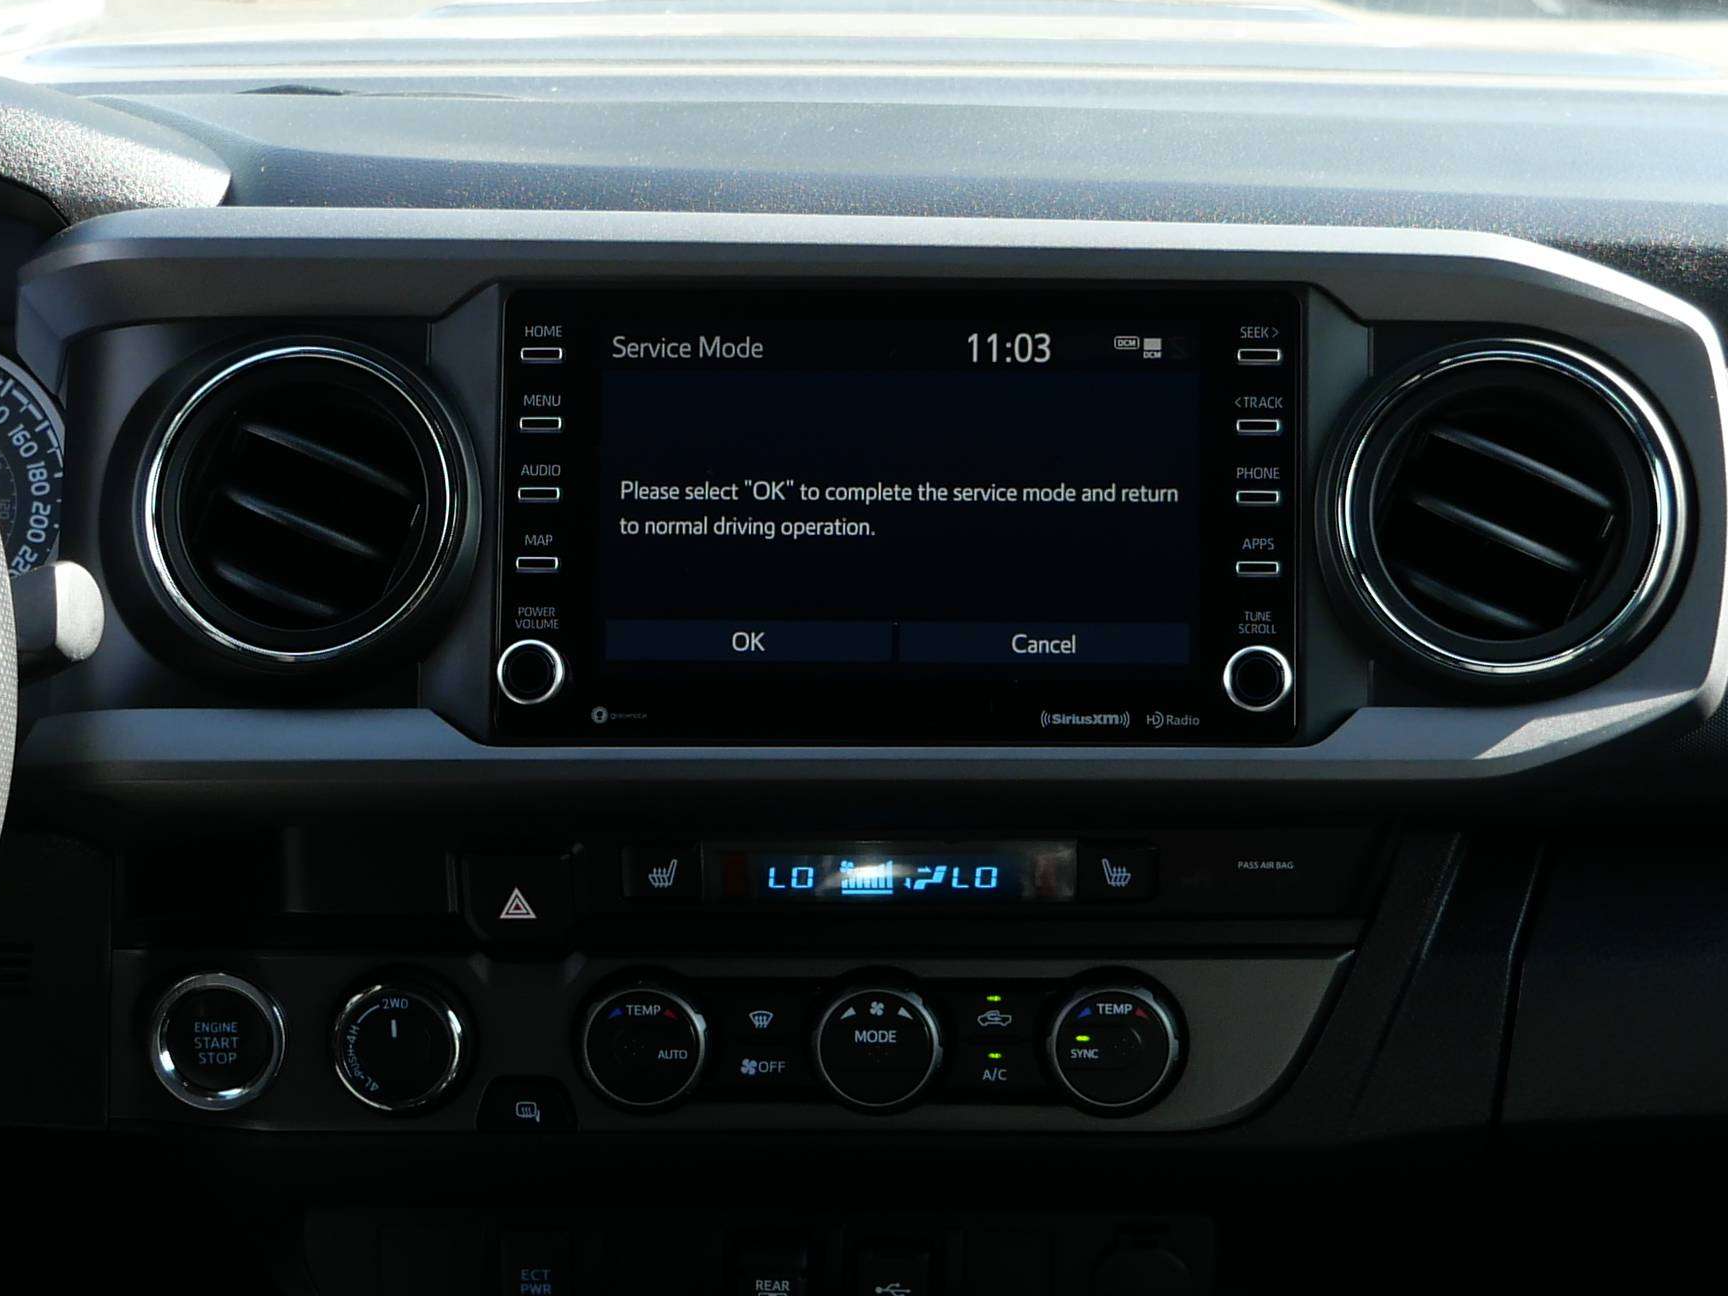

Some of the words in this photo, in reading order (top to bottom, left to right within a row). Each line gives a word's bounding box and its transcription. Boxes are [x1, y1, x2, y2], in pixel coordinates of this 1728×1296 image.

[524, 325, 563, 337] HOME
[1240, 326, 1270, 339] SEEK
[612, 335, 692, 359] Service
[699, 335, 764, 359] Mode
[966, 332, 1052, 364] 11:03
[523, 394, 561, 407] MENU
[1241, 395, 1284, 409] TRACK
[7, 423, 39, 459] 160
[521, 464, 561, 477] AUDIO
[1236, 466, 1281, 480] PHONE
[25, 460, 51, 497] 180
[620, 480, 680, 500] Please
[684, 481, 739, 501] select
[744, 479, 794, 501] "OK"
[800, 482, 820, 501] to
[825, 482, 912, 505] complete
[917, 482, 948, 502] the
[953, 483, 1017, 502] service
[1022, 482, 1076, 502] mode
[1081, 483, 1116, 503] and
[1121, 485, 1179, 503] return
[25, 501, 52, 544] 200
[619, 517, 640, 536] to
[645, 516, 708, 536] normal
[713, 516, 775, 540] driving
[780, 518, 876, 540] operation.
[524, 534, 554, 547] MAP
[1241, 537, 1276, 551] APPS
[518, 606, 556, 617] POWER
[1243, 610, 1272, 622] TUNE
[515, 619, 560, 630] VOLUME
[1237, 623, 1278, 635] SCROLL
[732, 631, 766, 653] OK
[1011, 633, 1077, 655] Cancel
[1166, 713, 1201, 727] Radio
[768, 867, 814, 889] LO
[951, 866, 998, 889] LO
[381, 997, 409, 1010] 2WD
[625, 1004, 661, 1017] TEMP
[1096, 1002, 1133, 1016] TEMP
[193, 1021, 240, 1034] ENGINE
[193, 1036, 240, 1050] START
[854, 1029, 898, 1044] MODE
[197, 1051, 239, 1065] STOP
[657, 1049, 689, 1060] AUTO
[1069, 1048, 1100, 1060] SYNC
[758, 1061, 787, 1073] OFF
[982, 1067, 1008, 1082] A/C
[519, 1267, 553, 1281] ECT
[519, 1282, 553, 1296] PWR
[754, 1279, 791, 1292] REAR
